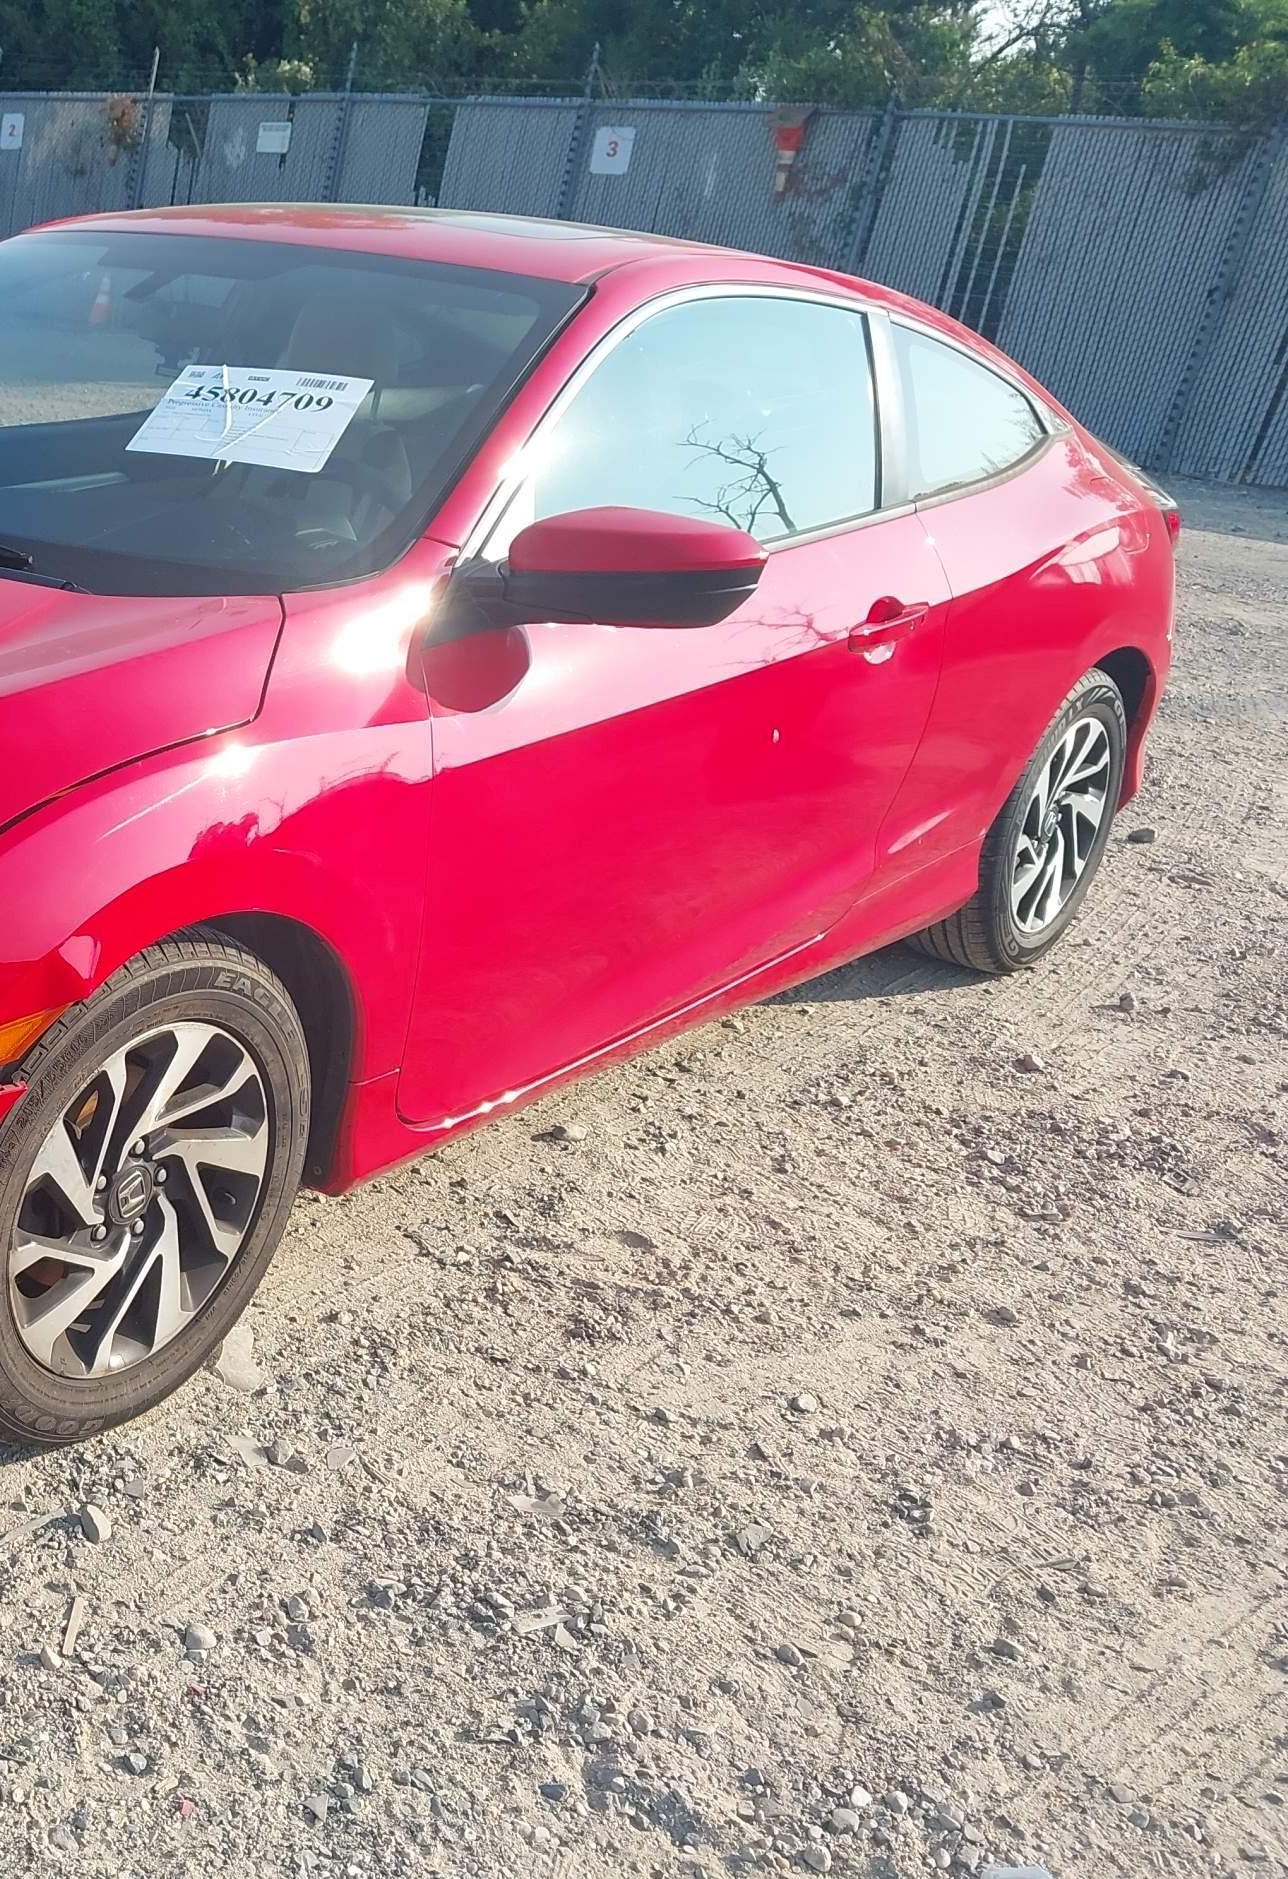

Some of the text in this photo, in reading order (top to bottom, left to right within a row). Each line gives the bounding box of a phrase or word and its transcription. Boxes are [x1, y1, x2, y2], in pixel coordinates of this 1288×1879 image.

[8, 123, 16, 137] 2
[606, 140, 619, 158] 3
[185, 385, 334, 412] 45804709
[213, 971, 297, 1042] EAGLE
